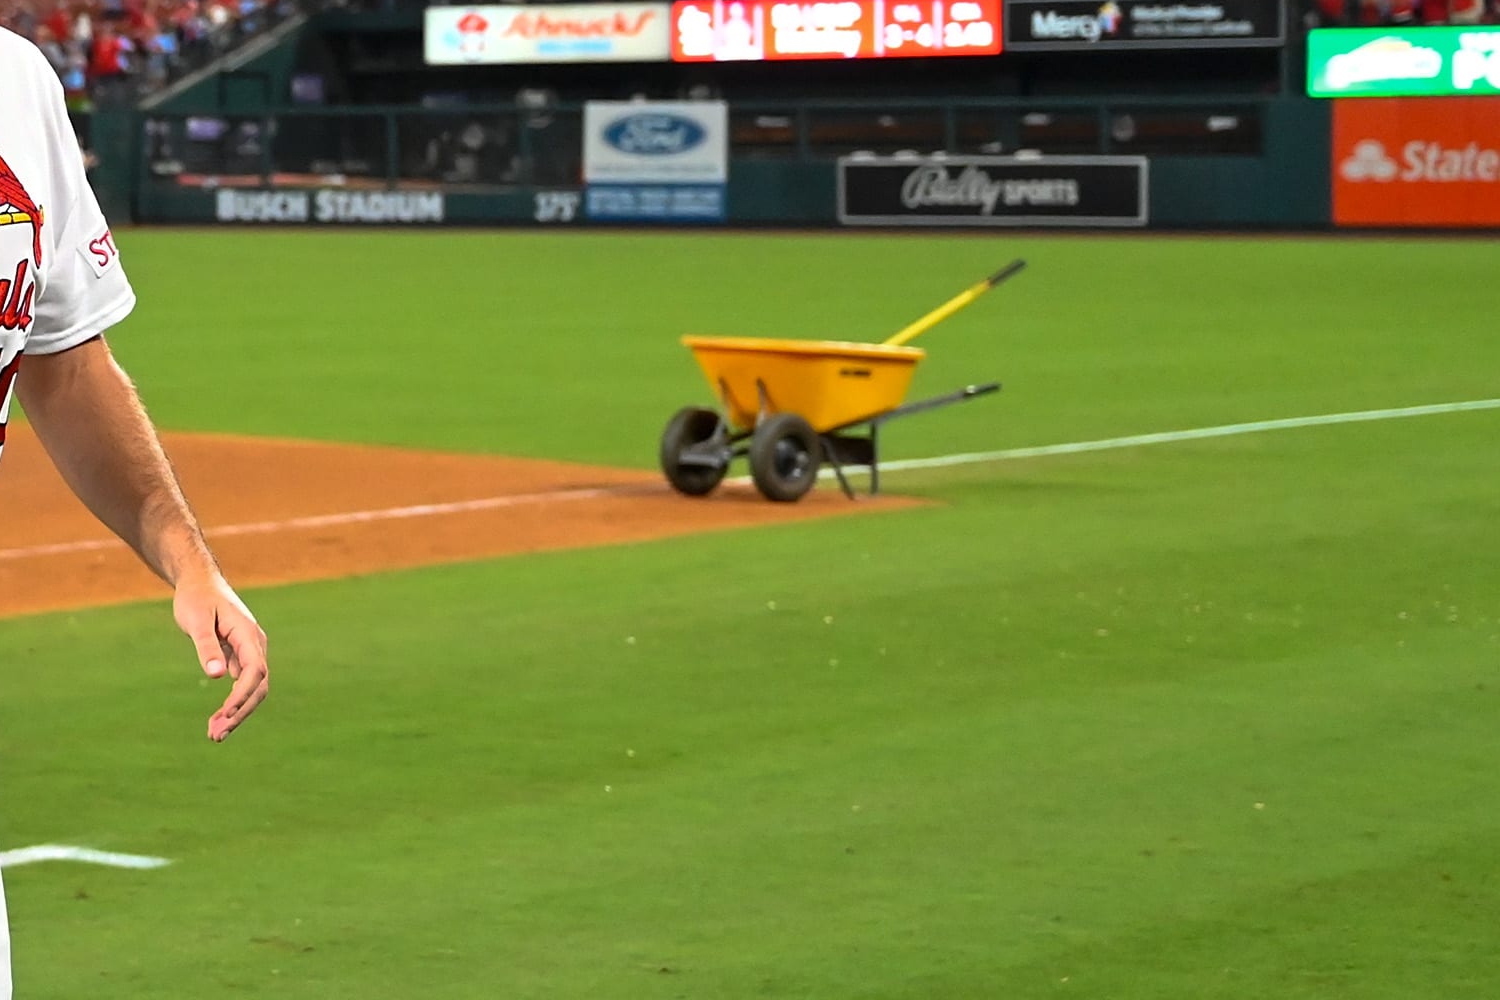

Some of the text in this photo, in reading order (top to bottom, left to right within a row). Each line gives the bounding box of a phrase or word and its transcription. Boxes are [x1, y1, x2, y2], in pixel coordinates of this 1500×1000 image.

[1031, 10, 1100, 42] Mercy
[1401, 139, 1500, 182] State
[216, 190, 443, 222] BUSCH STADIUM
